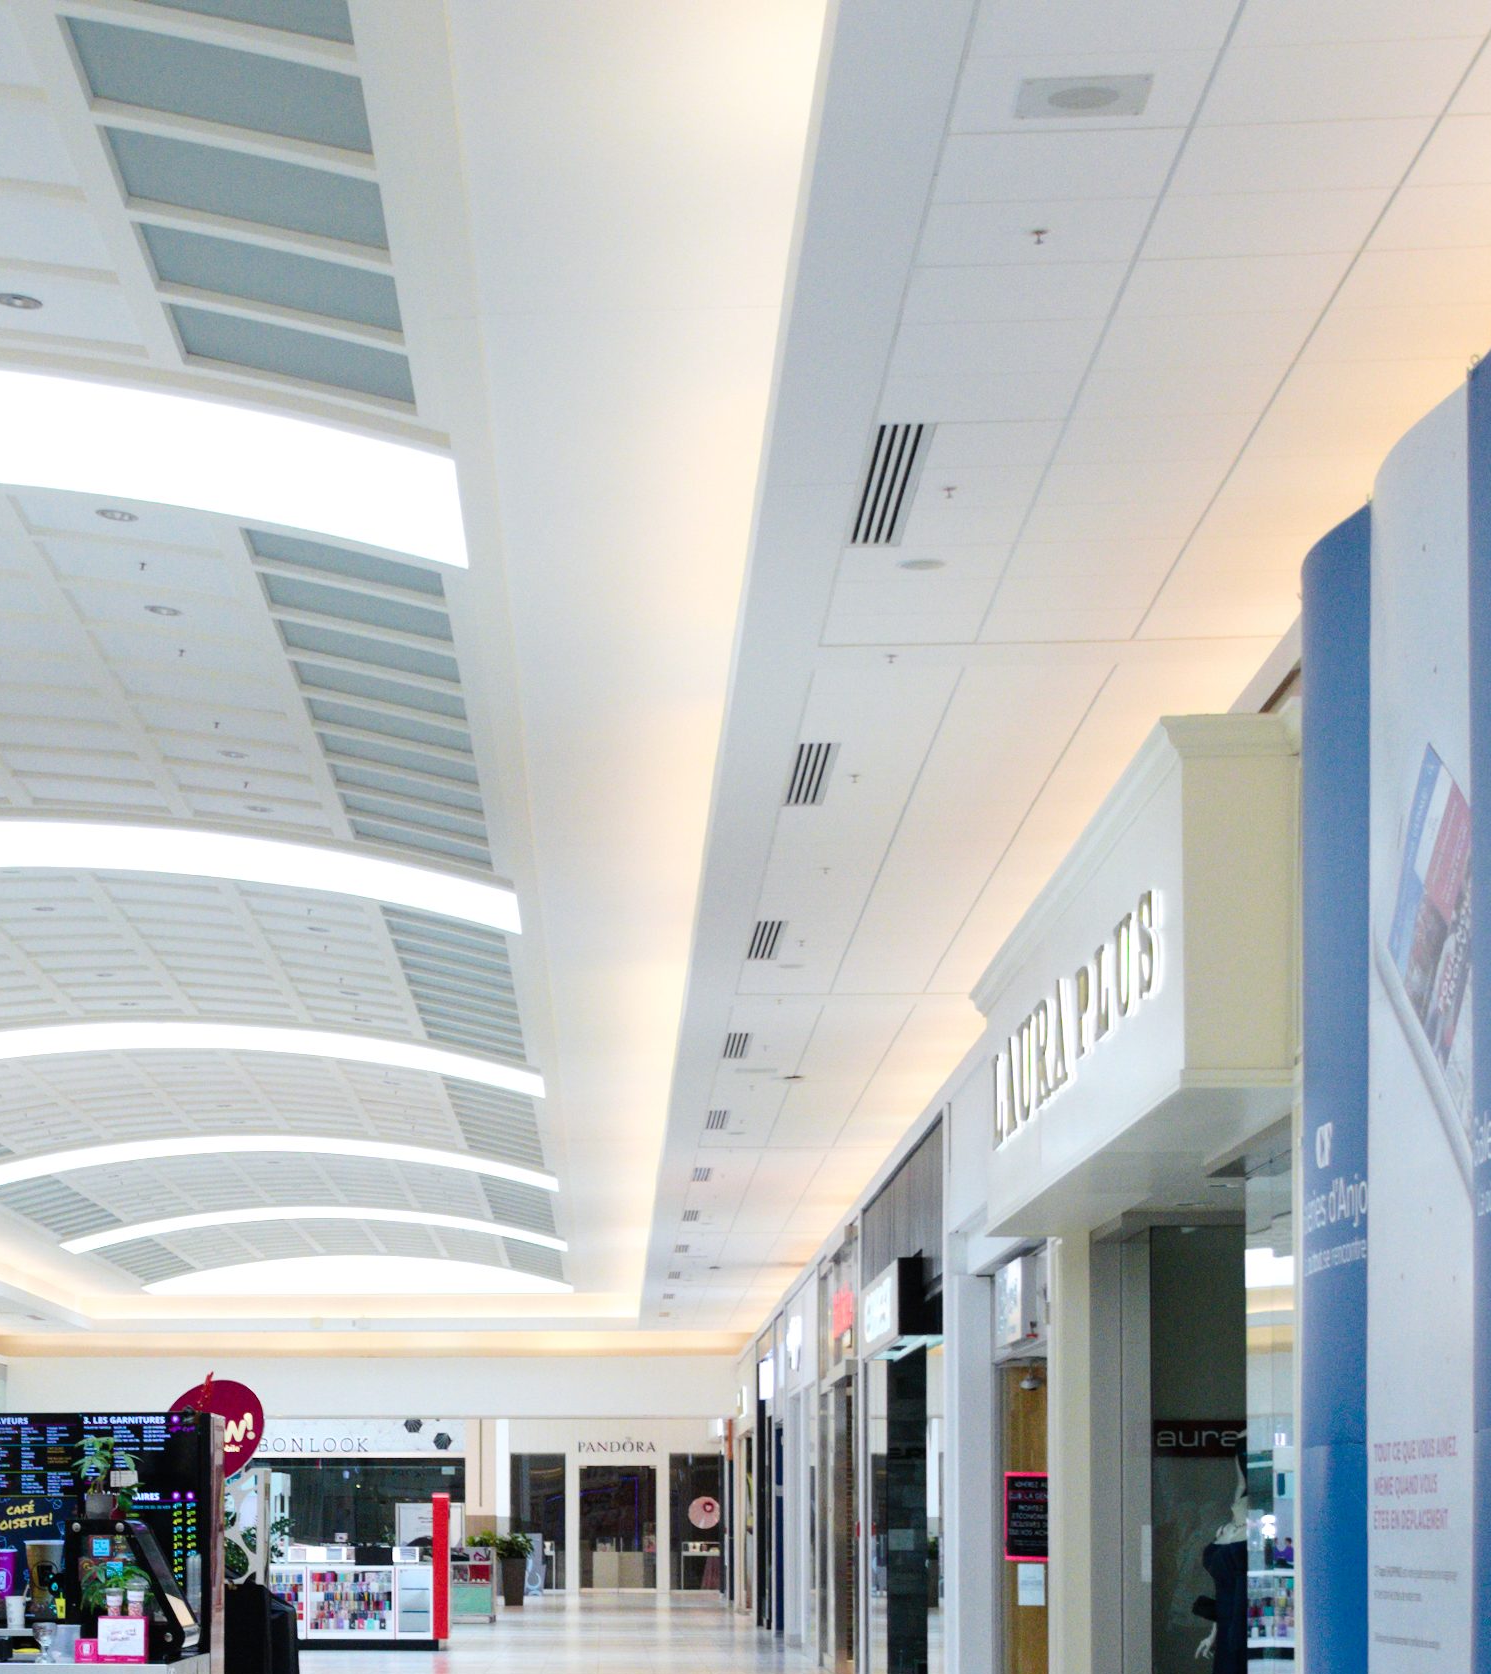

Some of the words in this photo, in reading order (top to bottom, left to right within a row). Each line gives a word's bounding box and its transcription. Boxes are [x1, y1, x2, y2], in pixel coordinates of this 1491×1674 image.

[993, 978, 1076, 1152] LAURA
[1076, 889, 1165, 1066] PLUS
[1328, 1173, 1368, 1228] d'Anjo
[92, 1416, 108, 1425] LES
[109, 1416, 166, 1425] GARNITURES
[223, 1412, 256, 1441] W!
[259, 1437, 370, 1453] BONLOOK
[578, 1440, 657, 1453] PANDORA
[1373, 1441, 1391, 1462] TOUT
[1391, 1441, 1401, 1461] CE
[1402, 1439, 1416, 1464] QUE
[1418, 1438, 1435, 1458] VOUS
[1395, 1474, 1418, 1499] QUAND
[1419, 1473, 1437, 1494] VOUS
[5, 1500, 35, 1516] CAFÉ
